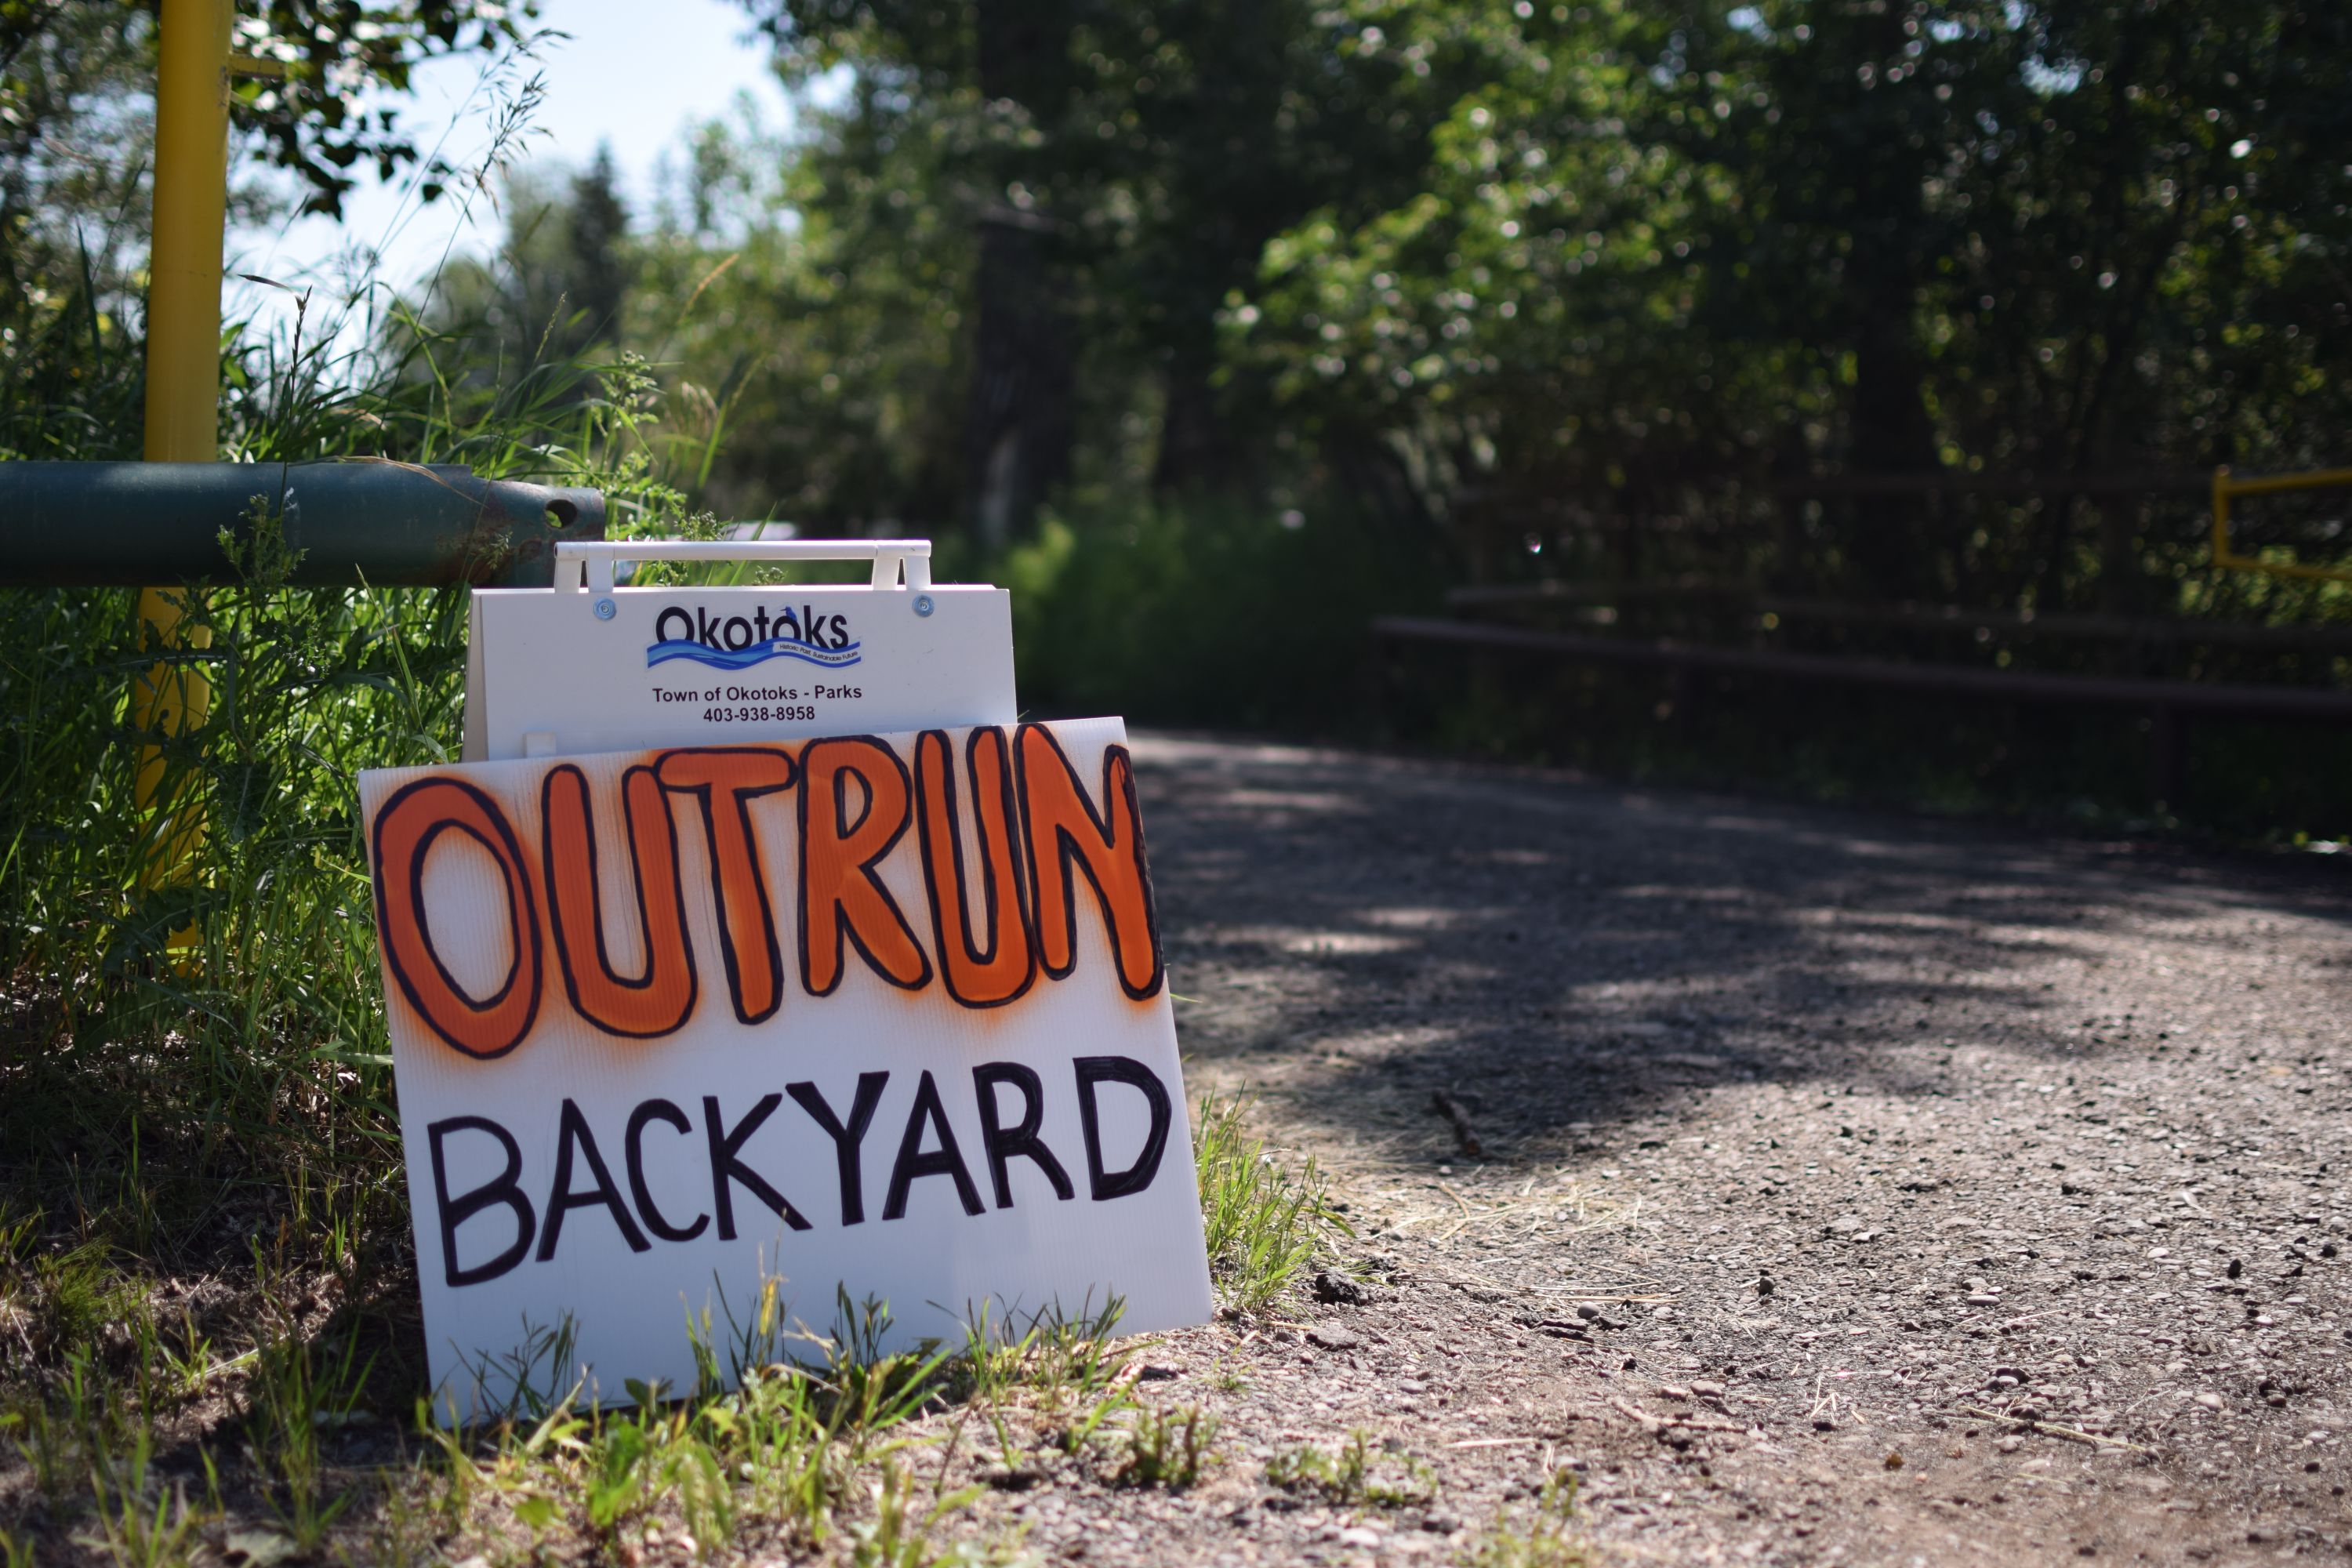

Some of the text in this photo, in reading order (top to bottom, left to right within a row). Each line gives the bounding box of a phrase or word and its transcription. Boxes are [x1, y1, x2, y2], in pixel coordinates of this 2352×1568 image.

[655, 604, 849, 652] Okotoks
[652, 688, 699, 702] Town
[704, 687, 721, 701] of
[726, 685, 798, 701] Okotoks
[815, 684, 862, 699] Parks
[703, 706, 815, 722] 403-938-8958
[372, 722, 1165, 1060] OUTRUN
[427, 1055, 1172, 1287] BACKYARD
